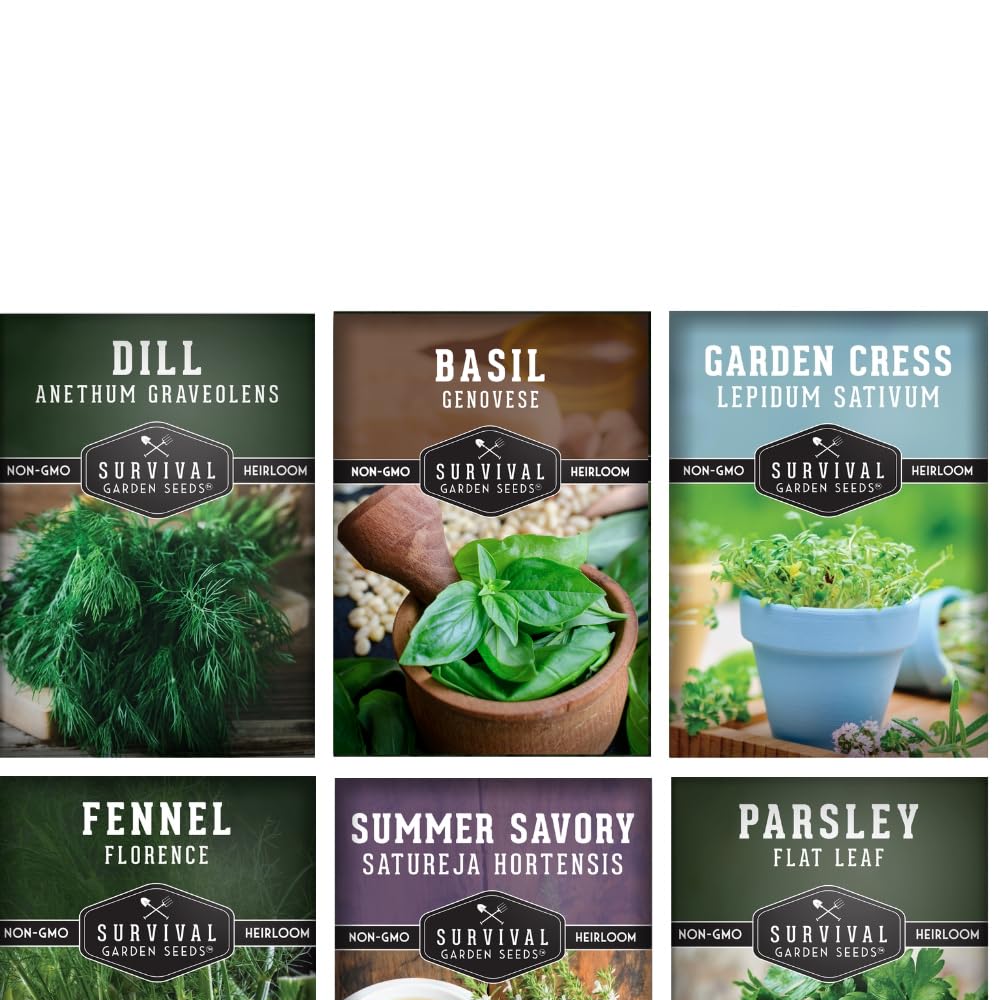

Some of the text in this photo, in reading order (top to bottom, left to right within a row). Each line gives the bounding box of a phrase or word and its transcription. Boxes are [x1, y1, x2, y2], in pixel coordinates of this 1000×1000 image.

[113, 341, 201, 375] DILL
[705, 345, 951, 376] GARDEN CRESS
[436, 349, 545, 382] BASIL
[36, 385, 278, 403] ANETHUM GRAVEOLENS
[443, 391, 538, 408] GENOVESE
[718, 386, 938, 407] LEPIDUM SATIVUM
[8, 465, 70, 475] NON-GMO
[99, 462, 215, 479] SURVIVAL
[244, 465, 307, 475] HEIRLOOM
[352, 467, 410, 476] NON-GMO
[437, 464, 544, 483] SURVIVAL
[571, 467, 629, 476] HEIRLOOM
[684, 466, 744, 475] NON-GMO
[772, 462, 884, 478] SURVIVAL
[912, 466, 972, 475] HEIRLOOM
[104, 483, 155, 493] GARDEN
[441, 484, 488, 493] GARDEN
[776, 483, 826, 492] GARDEN
[83, 802, 230, 835] FENNEL
[740, 804, 918, 839] PARSLEY
[352, 813, 634, 844] SUMMER SAVORY
[105, 846, 208, 864] FLORENCE
[774, 848, 884, 866] FLAT LEAF
[363, 853, 622, 875] SATUREJA HORTENSIS
[5, 928, 68, 938] NON-GMO
[98, 924, 216, 941] SURVIVAL
[246, 928, 309, 938] HEIRLOOM
[350, 932, 409, 942] NON-GMO
[437, 929, 548, 945] SURVIVAL
[576, 932, 636, 942] HEIRLOOM
[679, 929, 742, 939] NON-GMO
[771, 926, 887, 942] SURVIVAL
[916, 929, 979, 939] HEIRLOOM
[102, 946, 155, 956] GARDEN
[441, 949, 491, 959] GARDEN
[775, 947, 827, 957] GARDEN
